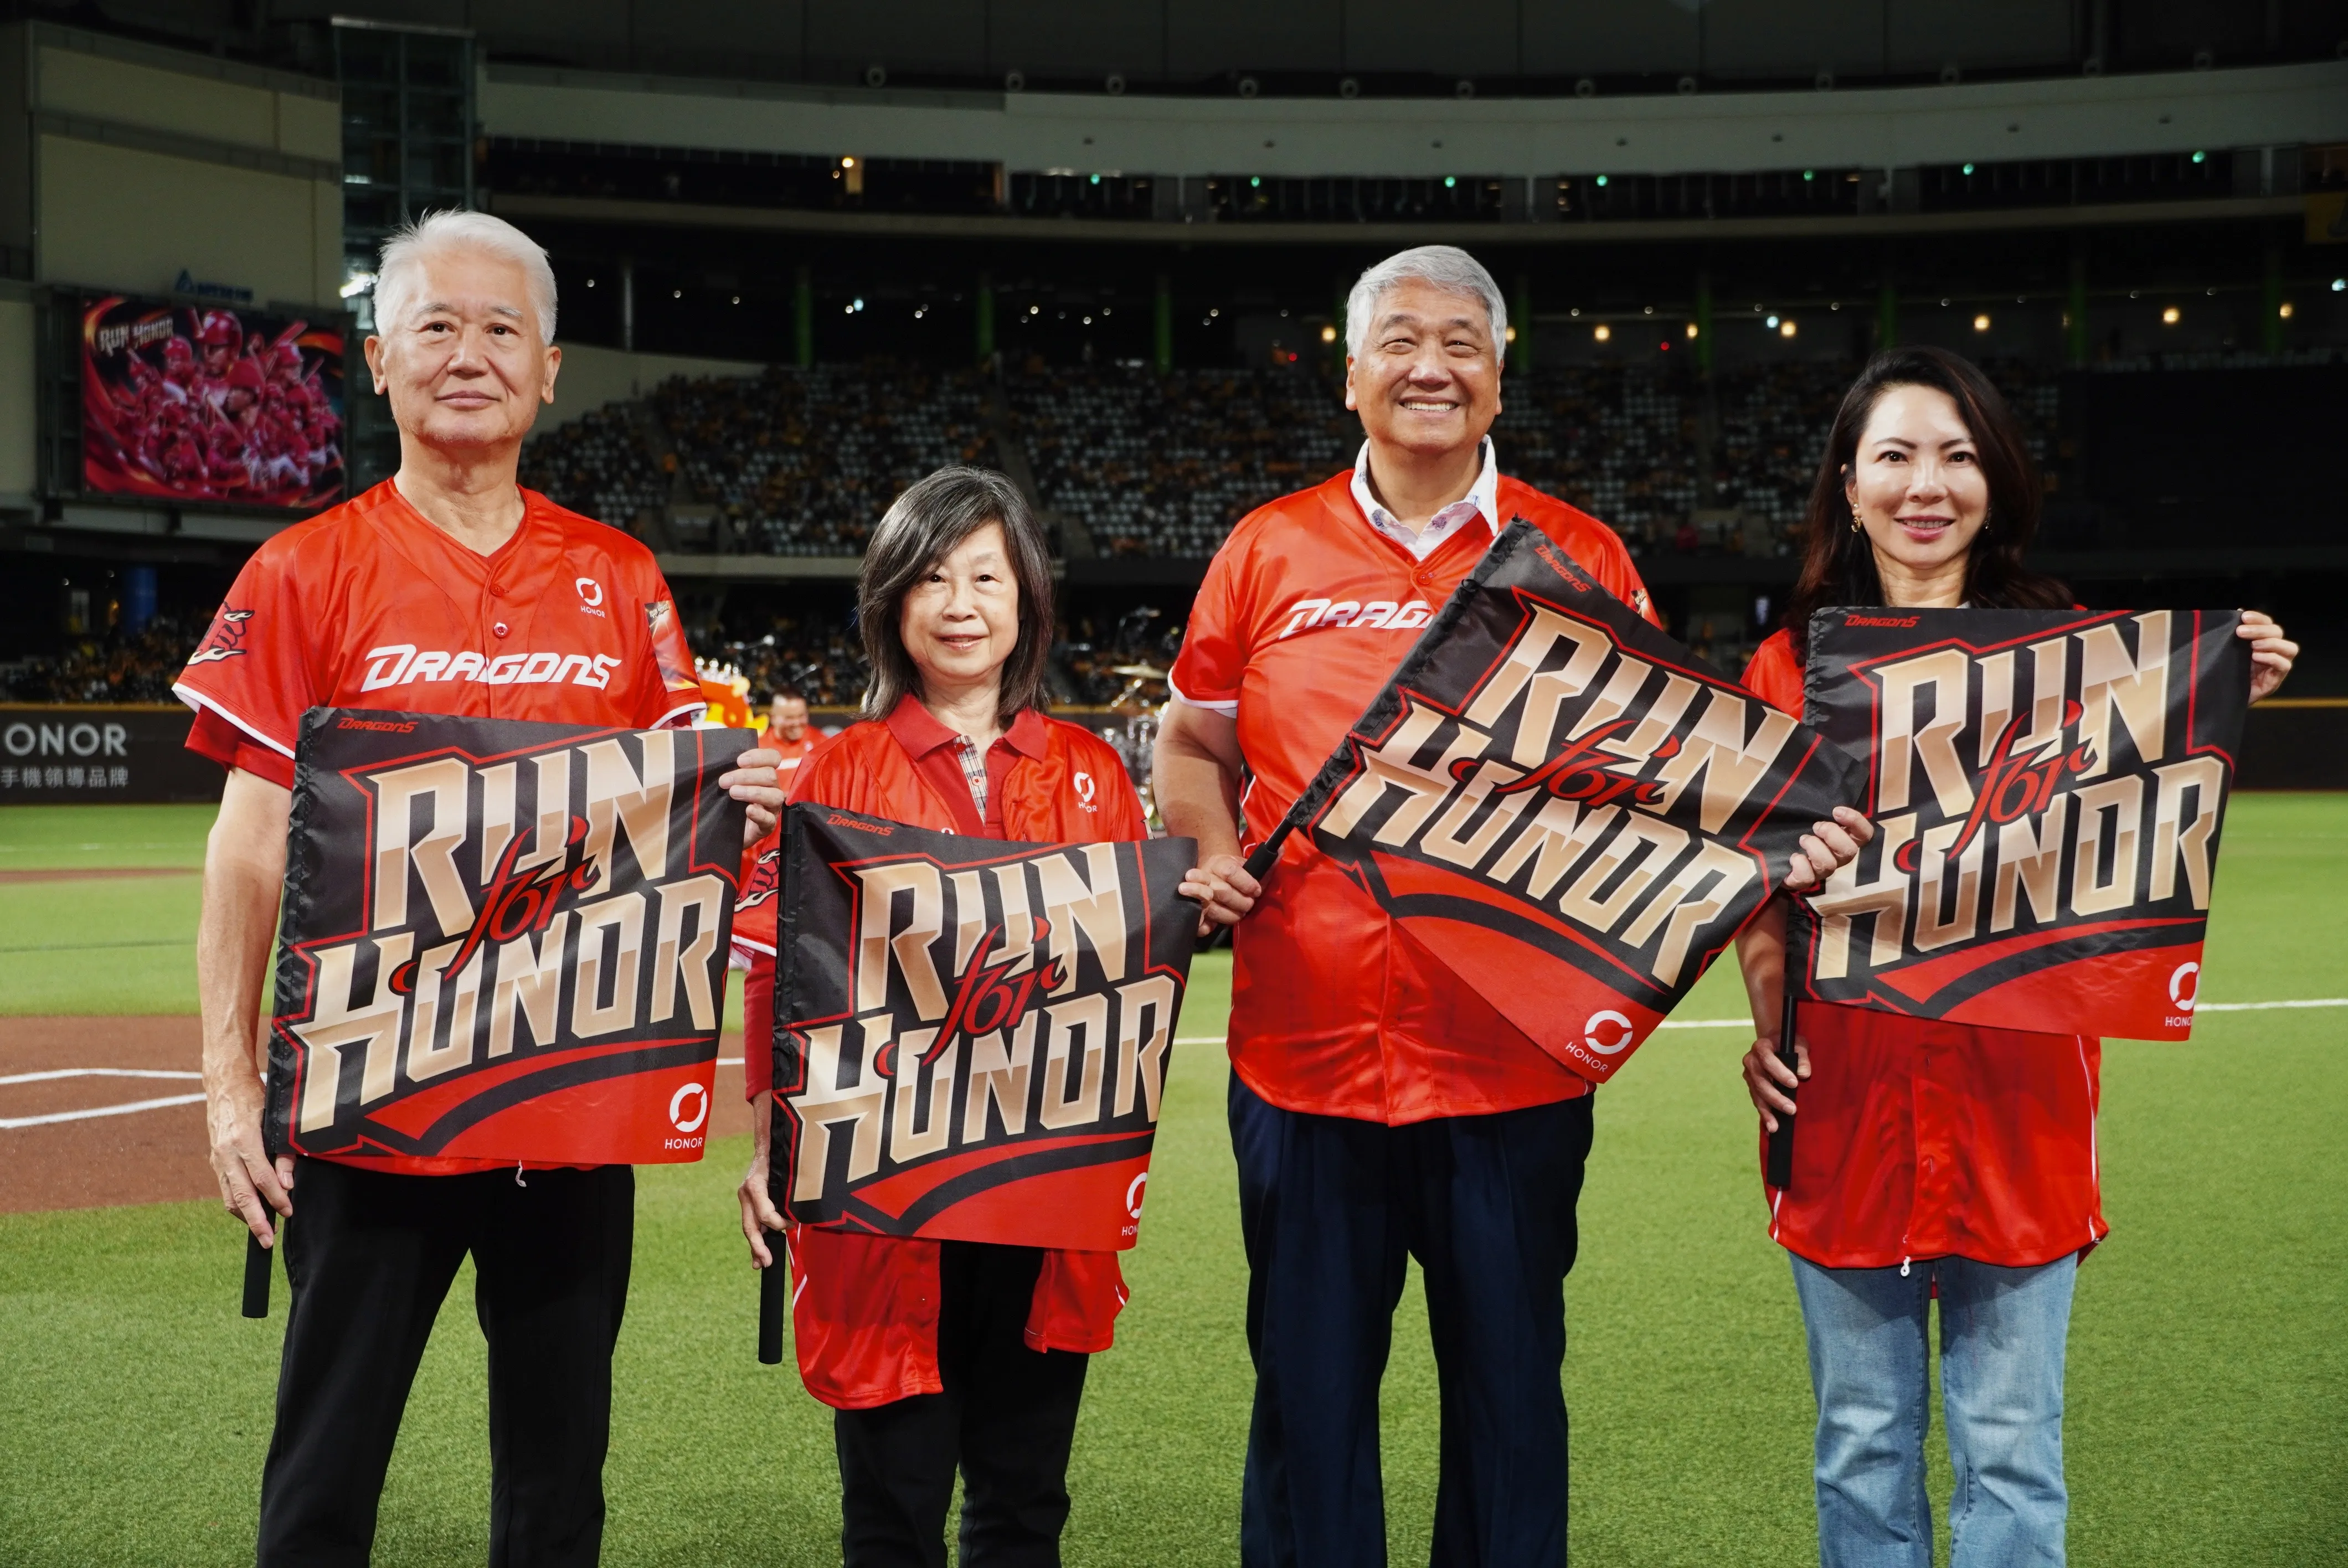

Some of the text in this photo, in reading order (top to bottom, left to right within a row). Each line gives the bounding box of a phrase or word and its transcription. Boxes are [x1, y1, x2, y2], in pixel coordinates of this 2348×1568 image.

[100, 324, 130, 358] RUN
[1534, 544, 1592, 593] DRAGONS
[580, 605, 606, 618] HONOR
[1279, 599, 1435, 639] DRAG
[1844, 615, 1921, 628] DRAGONS
[360, 643, 622, 693] DRAGONS
[337, 717, 419, 734] DRAGONS
[1464, 603, 1798, 835] RUN
[1873, 610, 2172, 817] RUN
[4, 722, 128, 757] ONOR
[1450, 720, 1665, 807] for
[1078, 801, 1098, 813] HOR
[1897, 699, 2098, 871] for
[366, 729, 675, 937] RUN
[826, 813, 895, 837] DRAGONS
[1319, 700, 1758, 989] HONOR
[1805, 755, 2225, 981] HONOR
[394, 816, 601, 992] for
[853, 842, 1127, 1022] RUN
[292, 875, 725, 1133] HONOR
[877, 916, 1068, 1076] for
[2165, 1015, 2193, 1027] HONO
[1565, 1041, 1608, 1072] HONOR
[787, 974, 1175, 1203] HONOR
[665, 1137, 703, 1149] HONOR
[1121, 1225, 1139, 1236] HON
